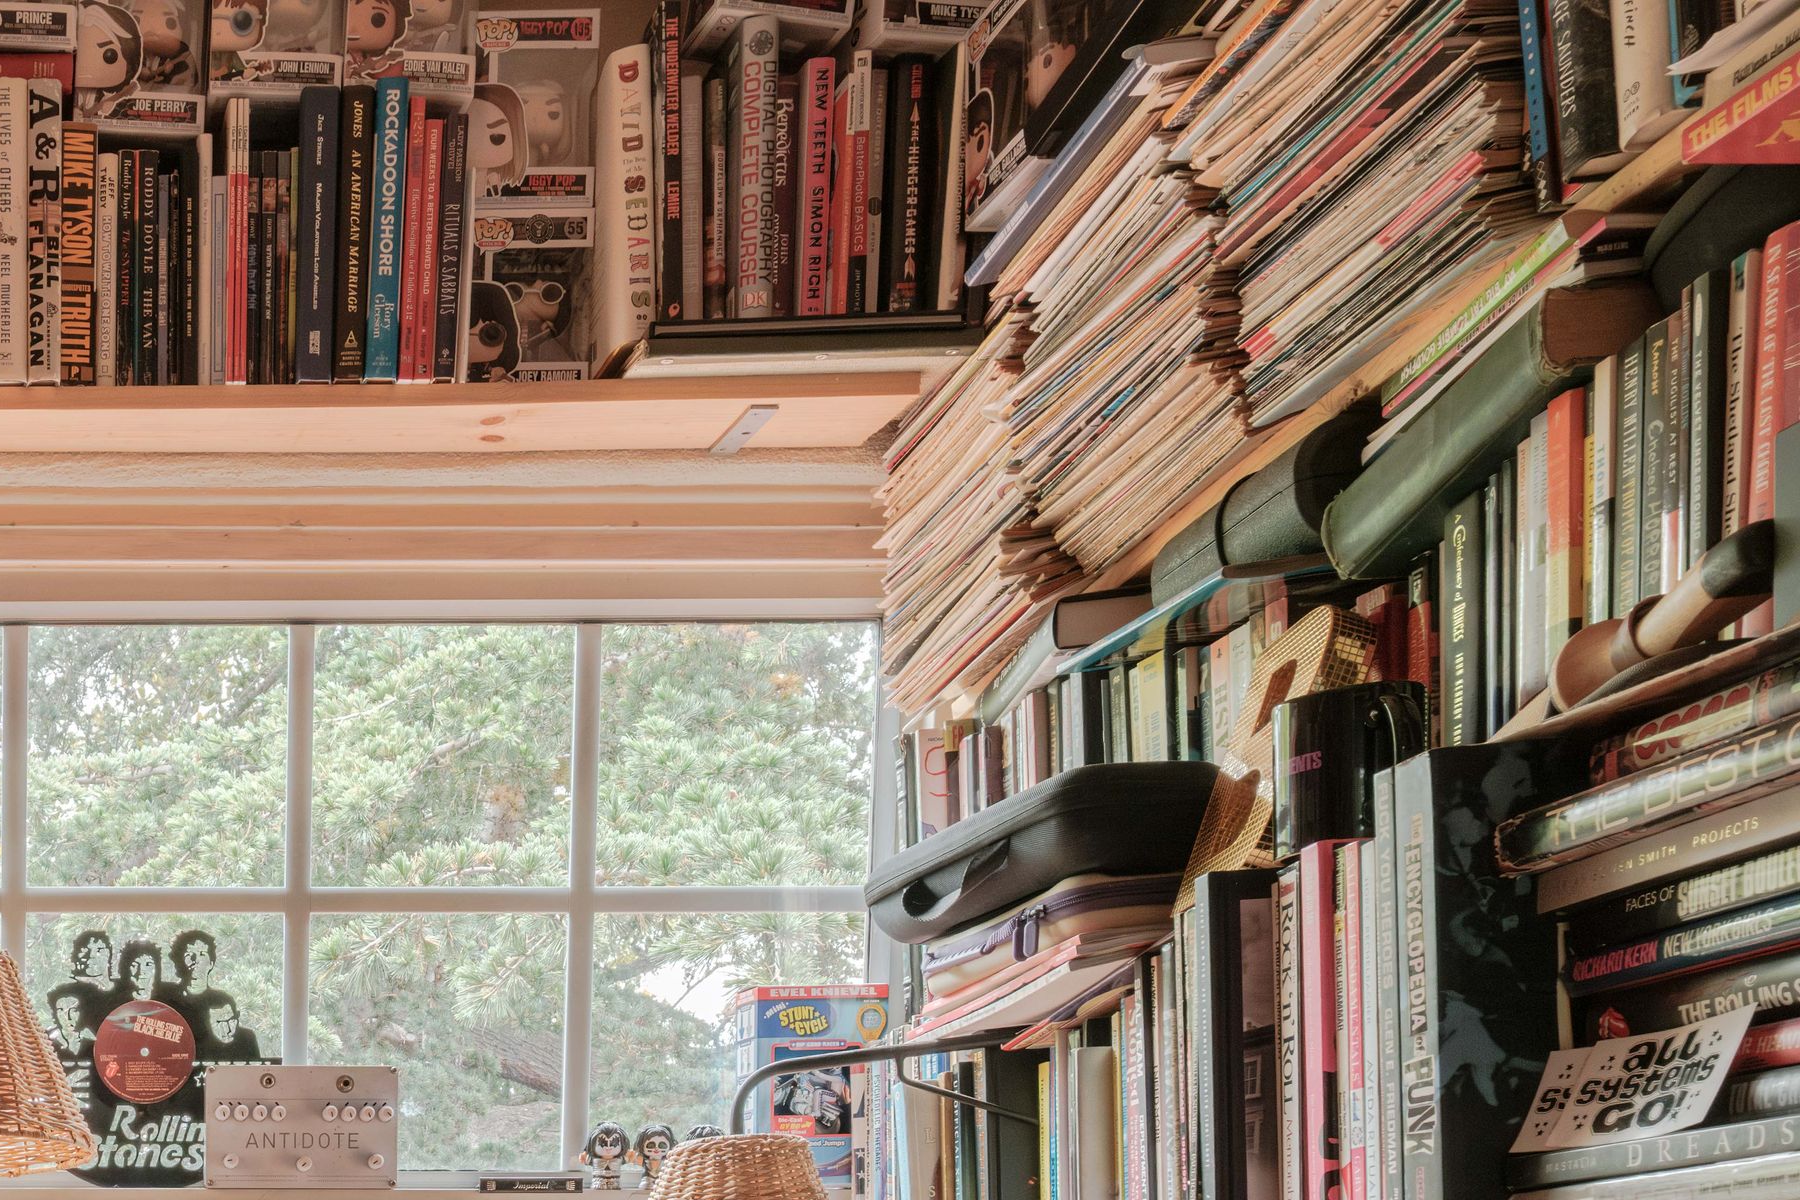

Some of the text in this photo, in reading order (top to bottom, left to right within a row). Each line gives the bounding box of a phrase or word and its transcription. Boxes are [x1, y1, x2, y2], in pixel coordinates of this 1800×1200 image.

[14, 12, 52, 26] PRINCE
[132, 99, 187, 113] JOE PERRY
[278, 60, 330, 75] JOHN LENNON
[404, 60, 466, 74] EDDIE VAN HALEN
[1557, 30, 1577, 118] SAUNDERS
[29, 88, 60, 206] A & R
[666, 16, 680, 220] THE UNDERWATER WELDER LEMIRE
[1688, 71, 1793, 151] THE FILMS
[62, 132, 94, 264] MIKE TYSON
[348, 100, 364, 312] JONES AN AMERICAN MARRIAGE
[378, 88, 400, 276] ROCKADOON SHORE
[618, 60, 650, 308] DAVID SEDARIS
[738, 61, 762, 288] COMPLETE COURSE
[758, 60, 778, 284] DIGITAL PHOTOGRAPHY
[806, 67, 830, 300] NEW TEETH SIMON RICH
[905, 124, 920, 254] THE HUNGER GAMES
[0, 86, 12, 344] THE LIVES of OTHERS NEEL MUKHERJEE
[28, 220, 44, 366] FLANAGAN
[46, 236, 60, 288] BILL
[142, 167, 154, 349] RODDY DOYLE THE VAN
[60, 293, 92, 364] TRUTH
[744, 292, 767, 308] DK
[1693, 350, 1702, 539] THE VELVET UNDERGROUND
[1453, 524, 1466, 589] Confederacy
[1452, 602, 1466, 643] DUNCES
[1544, 729, 1778, 848] THE BEST
[1280, 900, 1294, 982] ROCK
[1404, 846, 1428, 1036] ENCYCLOPEDIA
[1572, 940, 1660, 982] RICHARD KERN
[770, 985, 878, 997] EVEL KNIEVEL
[778, 1006, 816, 1028] STUNT
[794, 1016, 829, 1036] CYCLE
[1282, 1034, 1296, 1116] ROLL
[1403, 1056, 1437, 1156] FUNK
[110, 1104, 206, 1142] Rollin
[244, 1131, 360, 1150] ANTIDOTE
[1626, 1115, 1794, 1168] DREADS
